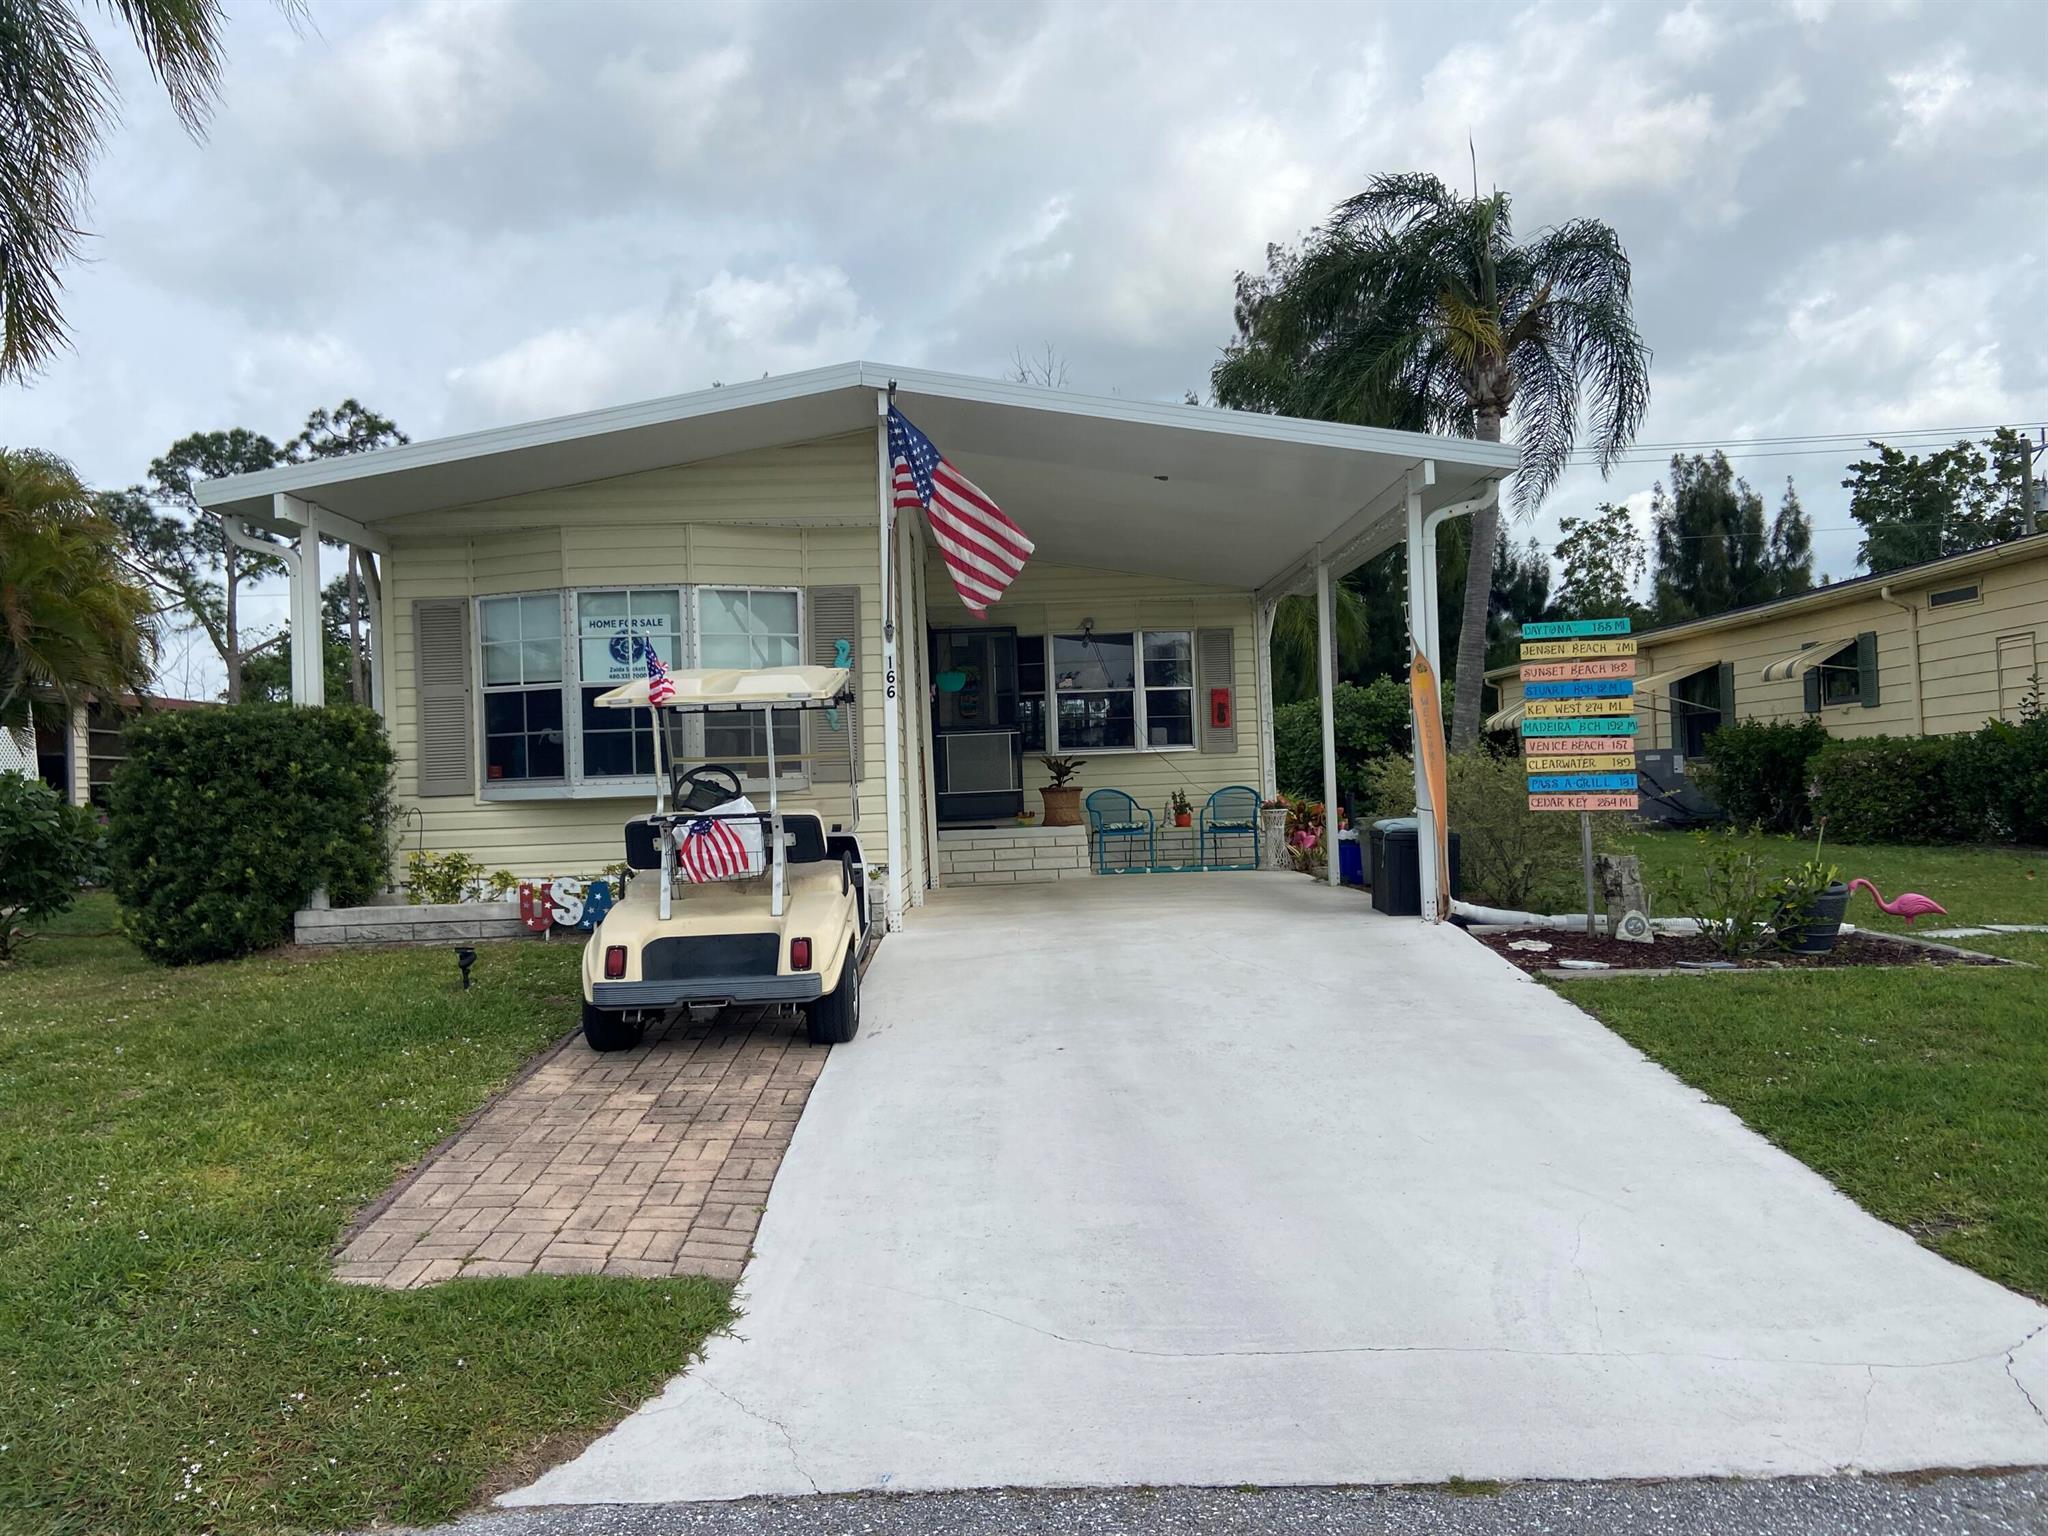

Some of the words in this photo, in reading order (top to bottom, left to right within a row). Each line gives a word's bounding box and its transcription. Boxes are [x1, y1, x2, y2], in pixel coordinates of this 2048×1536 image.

[589, 620, 617, 628] HOME
[619, 619, 638, 627] FOR
[640, 618, 663, 626] SALE
[1524, 625, 1573, 635] DAYTONA
[1615, 621, 1625, 630] MI
[1522, 646, 1565, 656] JENSEN
[1572, 644, 1606, 654] BEACH
[1524, 666, 1565, 677] SUNSET
[1571, 664, 1606, 675] BEACH
[887, 656, 895, 698] 166
[1526, 685, 1564, 696] STUART
[1574, 685, 1593, 694] BCH
[1527, 705, 1549, 715] KEY
[1555, 703, 1581, 714] WEST
[1585, 703, 1603, 712] 274
[1609, 702, 1622, 710] MI
[1523, 723, 1571, 732] MADEIRA
[1579, 721, 1601, 732] BCH
[1607, 721, 1623, 730] 192
[1529, 741, 1567, 750] VENICE
[1571, 740, 1604, 750] BEACH
[1529, 758, 1596, 769] CLEARWATER
[1612, 758, 1631, 767] 189
[1532, 780, 1558, 789] PASS
[1531, 798, 1564, 807] CEDAR
[1568, 797, 1587, 808] KEY
[1620, 797, 1631, 806] MI
[519, 877, 613, 932] USA
